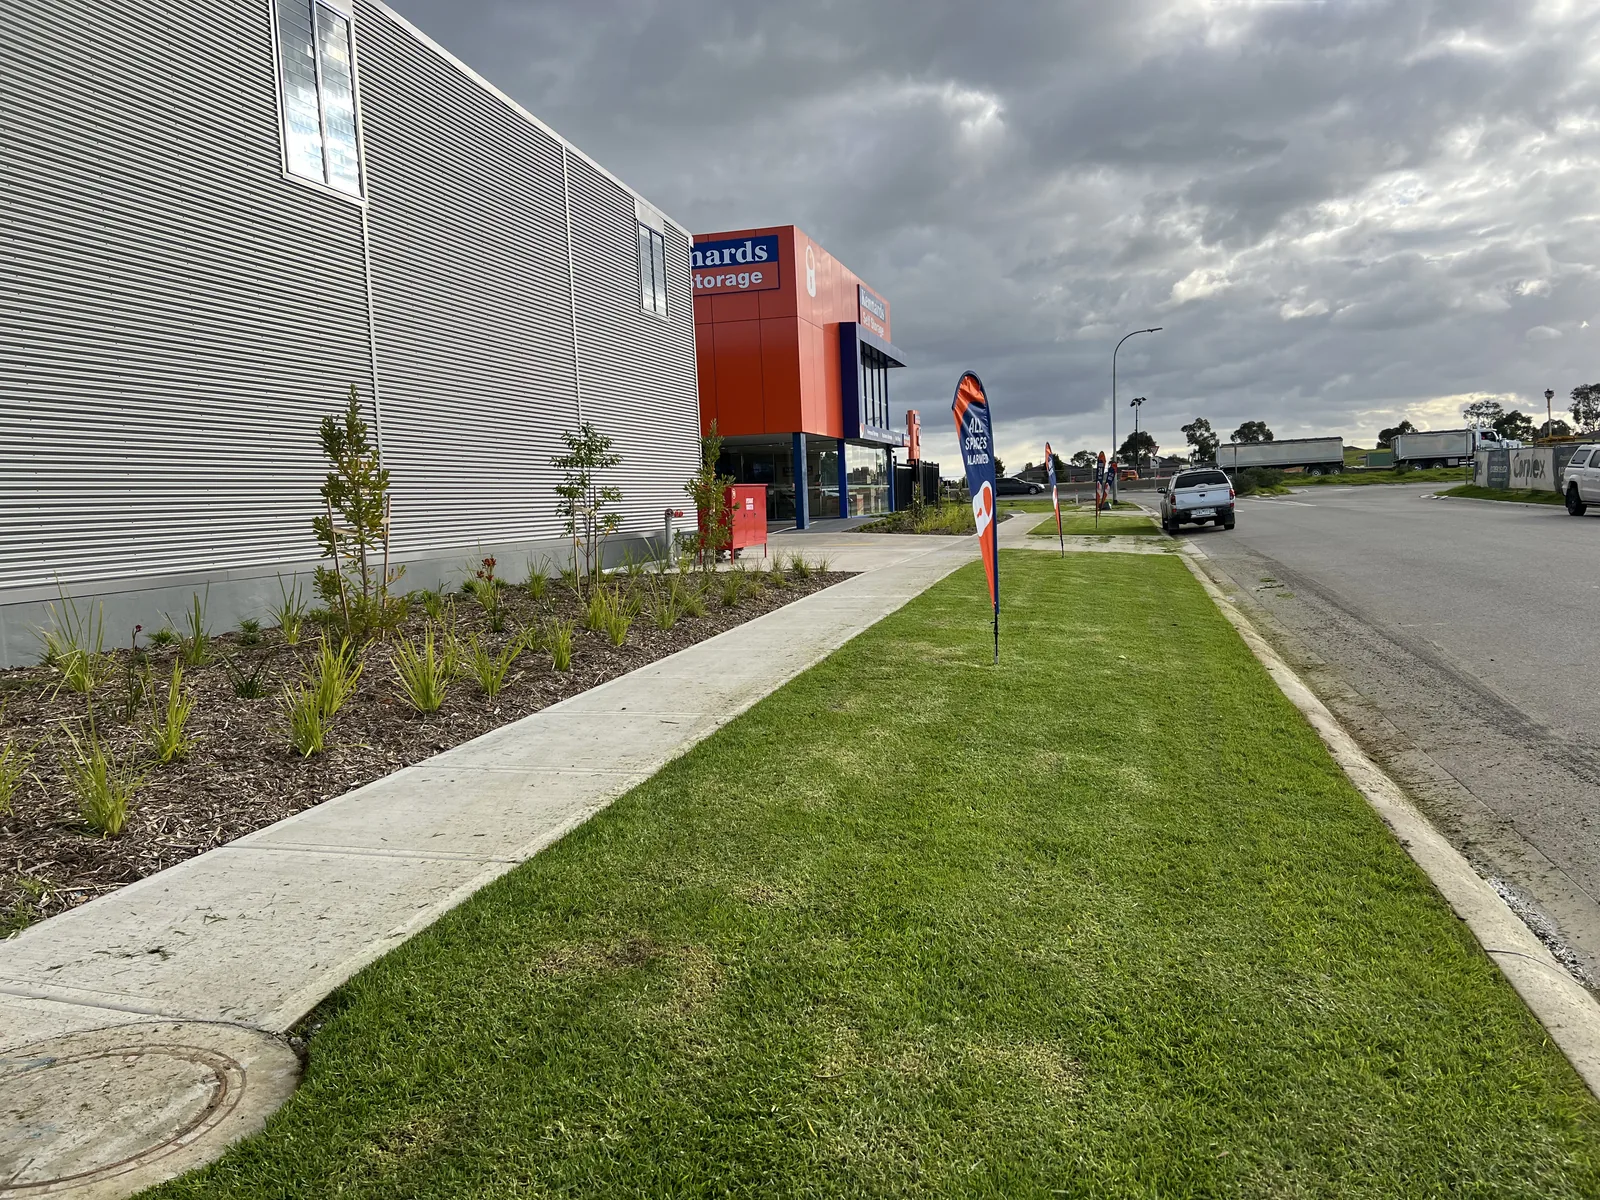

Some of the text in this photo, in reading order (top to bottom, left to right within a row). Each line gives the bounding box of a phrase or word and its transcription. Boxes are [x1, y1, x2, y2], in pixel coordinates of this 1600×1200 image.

[691, 271, 763, 289] torage
[968, 417, 984, 433] ALL
[965, 436, 988, 451] SPACES
[967, 453, 990, 466] ALARMED
